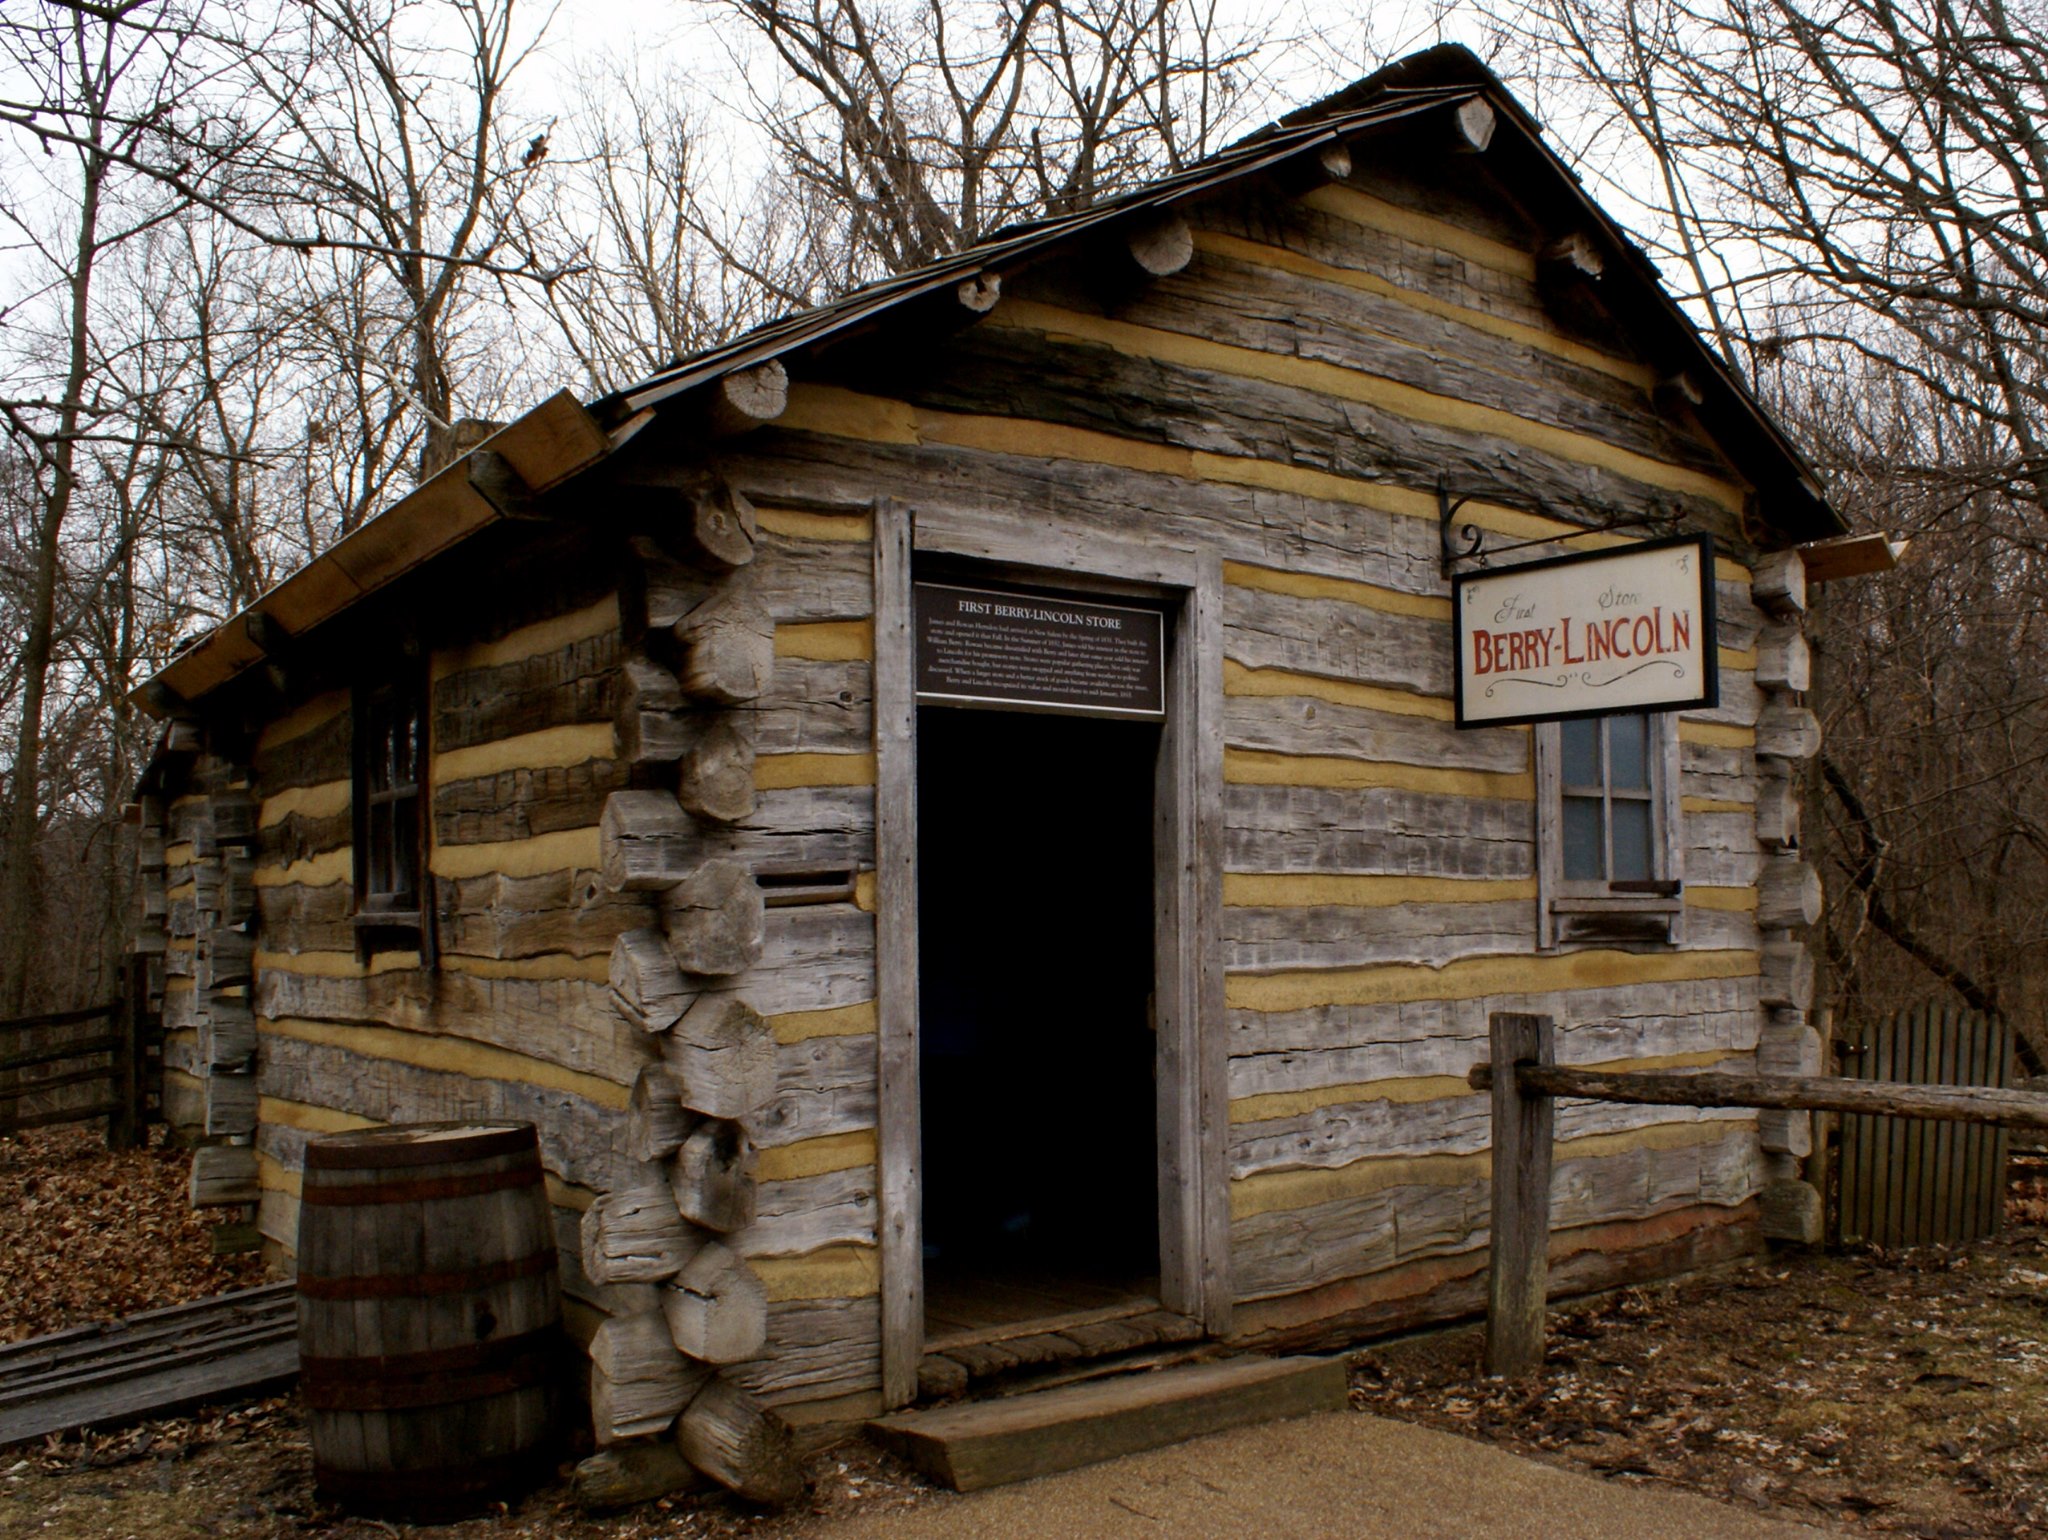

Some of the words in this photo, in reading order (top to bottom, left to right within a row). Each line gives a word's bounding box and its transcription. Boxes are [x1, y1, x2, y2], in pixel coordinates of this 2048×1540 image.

[958, 600, 992, 615] FIRST
[994, 606, 1084, 625] BERRY-LINCOLN
[1085, 616, 1122, 630] STORE
[1472, 606, 1691, 675] BERRY-LINCOLN
